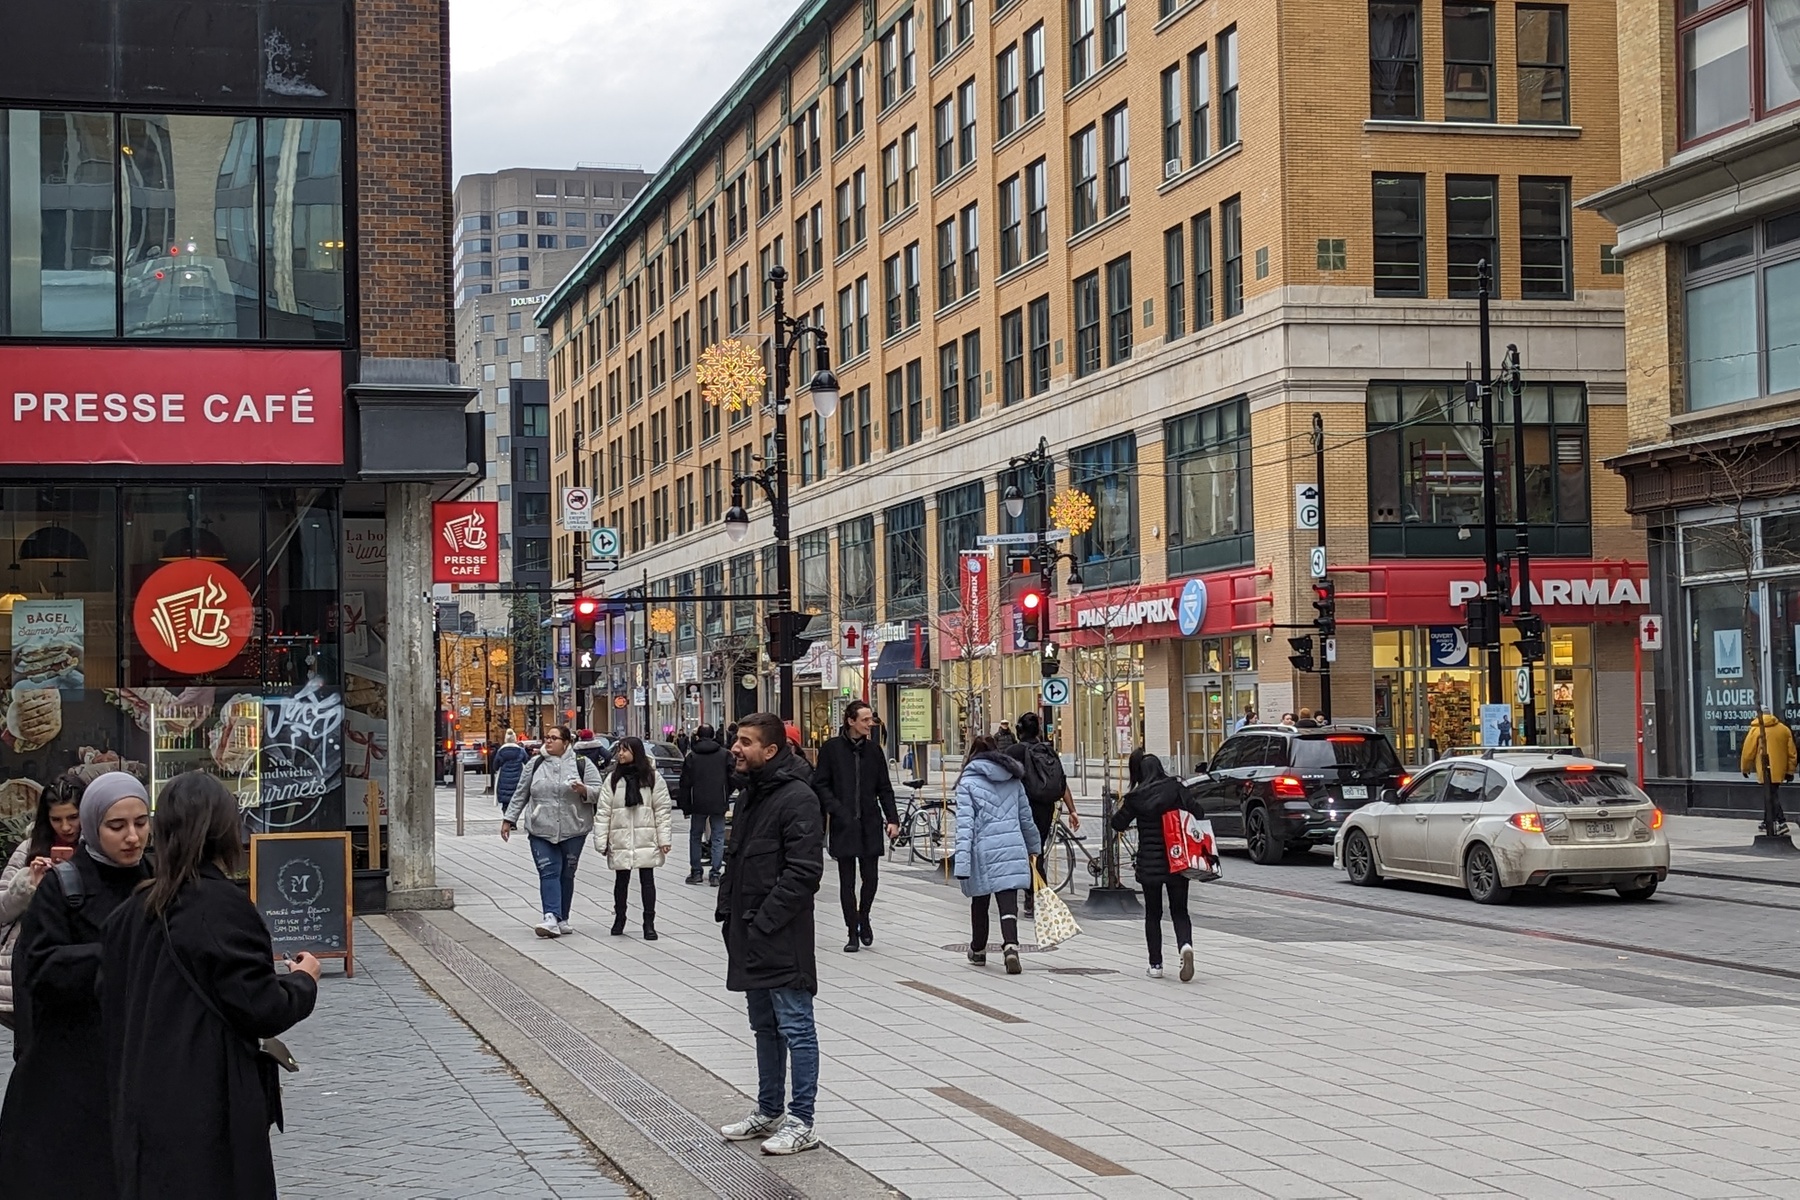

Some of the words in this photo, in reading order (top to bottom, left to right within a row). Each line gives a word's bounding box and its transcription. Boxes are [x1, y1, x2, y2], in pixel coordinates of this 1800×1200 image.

[14, 393, 186, 422] PRESSE
[203, 388, 315, 423] CAFÉ
[346, 530, 362, 541] La
[347, 542, 354, 554] à
[444, 556, 488, 564] PRESSE
[452, 565, 480, 574] CAFÉ
[26, 612, 69, 624] BAGEL
[1440, 642, 1454, 652] 22
[1706, 686, 1714, 706] À
[1716, 689, 1755, 706] LOUER
[1786, 683, 1795, 704] À
[1704, 710, 1722, 720] (514)
[1723, 710, 1758, 720] 933-3000
[268, 757, 293, 768] Nos
[238, 778, 326, 814] gourmets
